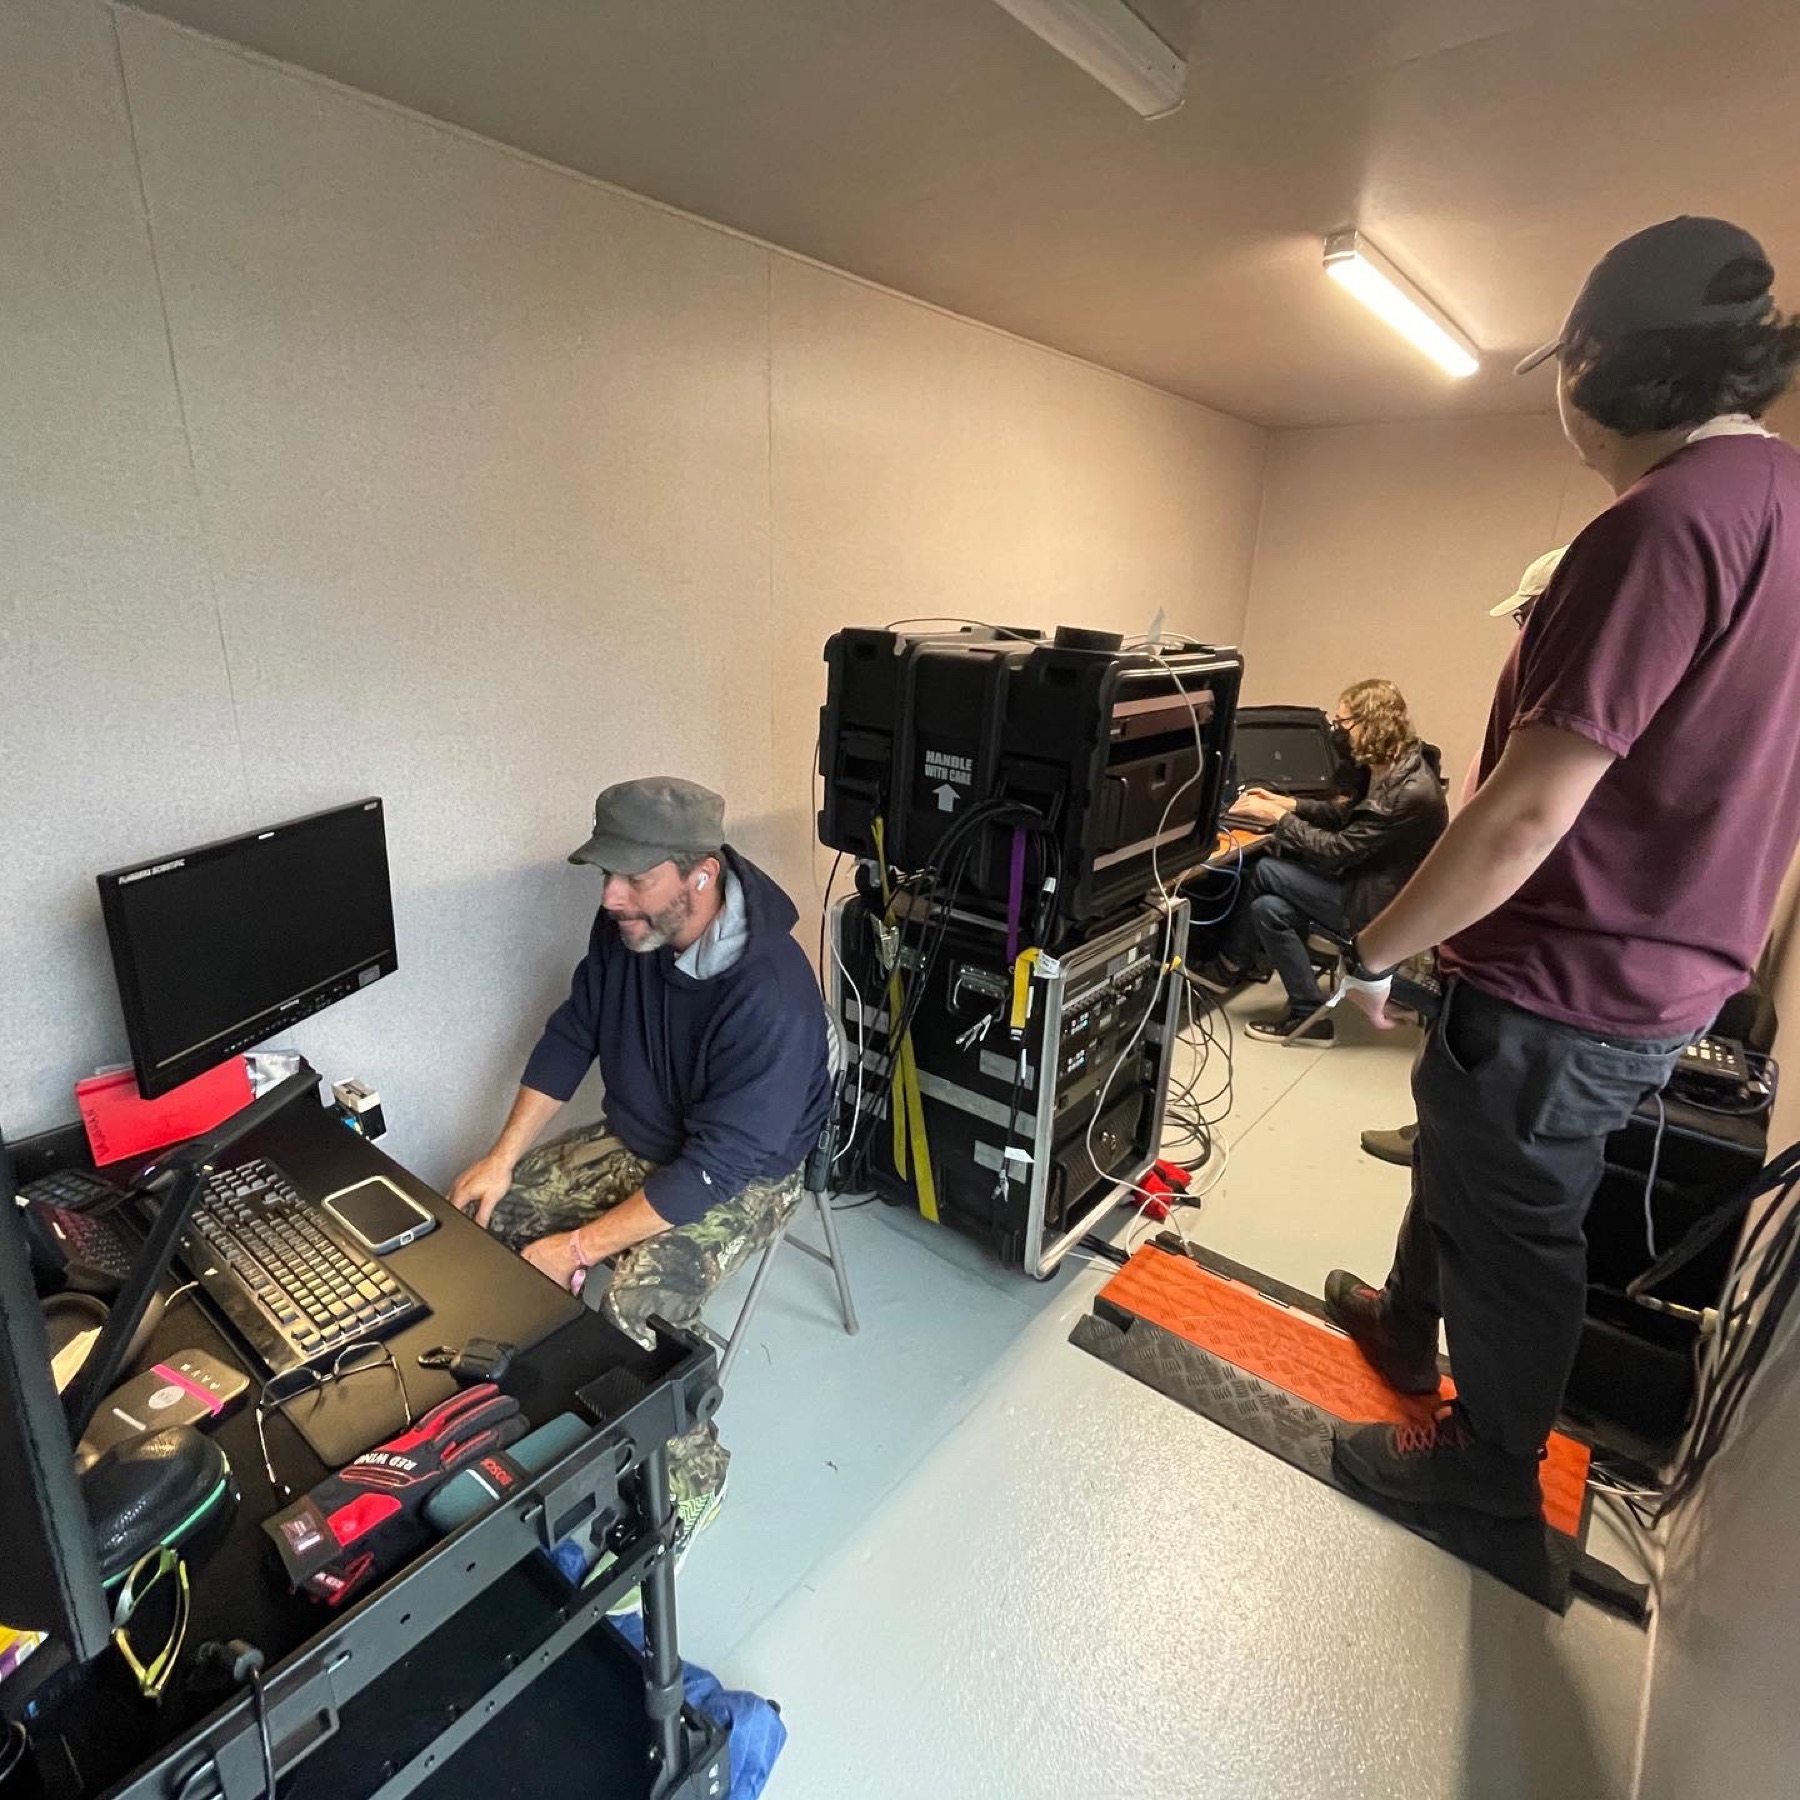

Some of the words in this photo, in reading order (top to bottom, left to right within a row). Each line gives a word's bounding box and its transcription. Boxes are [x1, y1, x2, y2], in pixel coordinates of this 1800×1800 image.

[925, 750, 973, 771] HANDLE
[925, 764, 949, 780] WITH
[949, 769, 972, 785] CARE
[389, 1456, 418, 1471] RED
